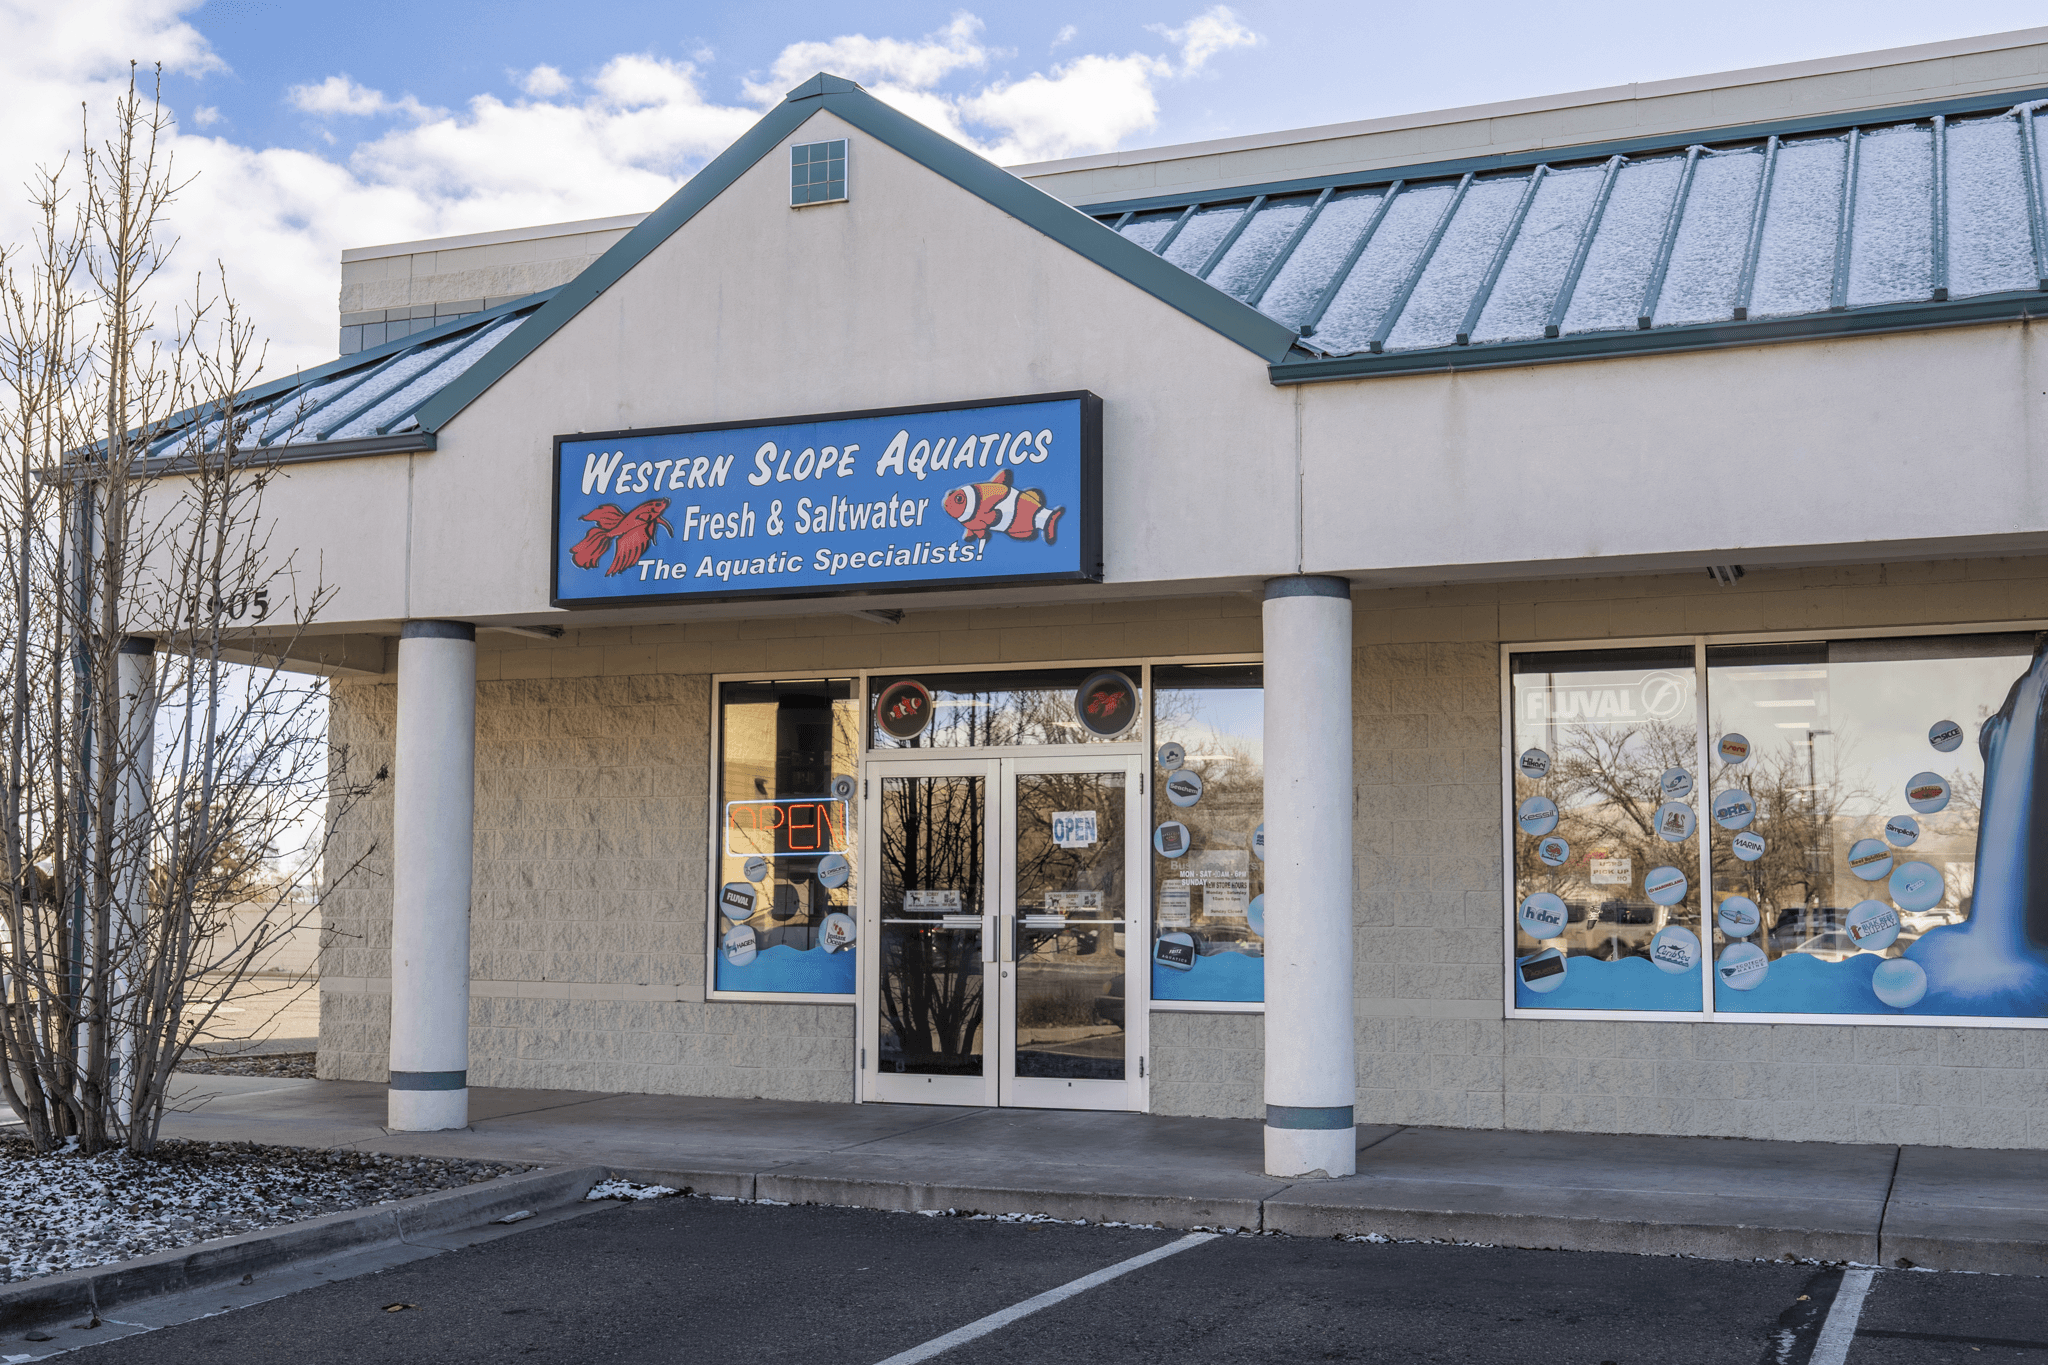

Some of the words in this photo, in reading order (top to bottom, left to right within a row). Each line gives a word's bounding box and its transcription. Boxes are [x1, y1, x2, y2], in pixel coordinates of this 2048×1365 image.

[581, 450, 734, 495] WESTERN
[747, 441, 861, 486] SLOPE
[875, 429, 1053, 481] AQUATICS
[682, 501, 756, 541] Fresh
[766, 498, 785, 537] &
[794, 491, 931, 535] Saltwater
[637, 558, 688, 581] The
[694, 550, 804, 583] Aquatic
[813, 538, 987, 576] Specialists!
[1526, 689, 1637, 719] FLUVAL
[1940, 727, 1961, 741] SICCE
[1522, 756, 1547, 769] Hikari
[1169, 781, 1199, 795] Seachem
[1519, 809, 1555, 822] Kessil
[1054, 817, 1096, 842] OPEN
[1886, 823, 1918, 839] Simplicity
[1734, 838, 1763, 853] MARINA
[1179, 870, 1195, 878] MON
[1199, 870, 1212, 878] SAT
[1181, 878, 1208, 886] SUNDAY
[1216, 881, 1231, 889] STORE
[1231, 881, 1248, 889] HOURS
[726, 891, 750, 907] FLUVAL
[827, 931, 847, 942] Instant
[736, 938, 756, 950] HAGEN
[1161, 954, 1188, 963] AQUATICS
[1737, 962, 1764, 973] MARINE
